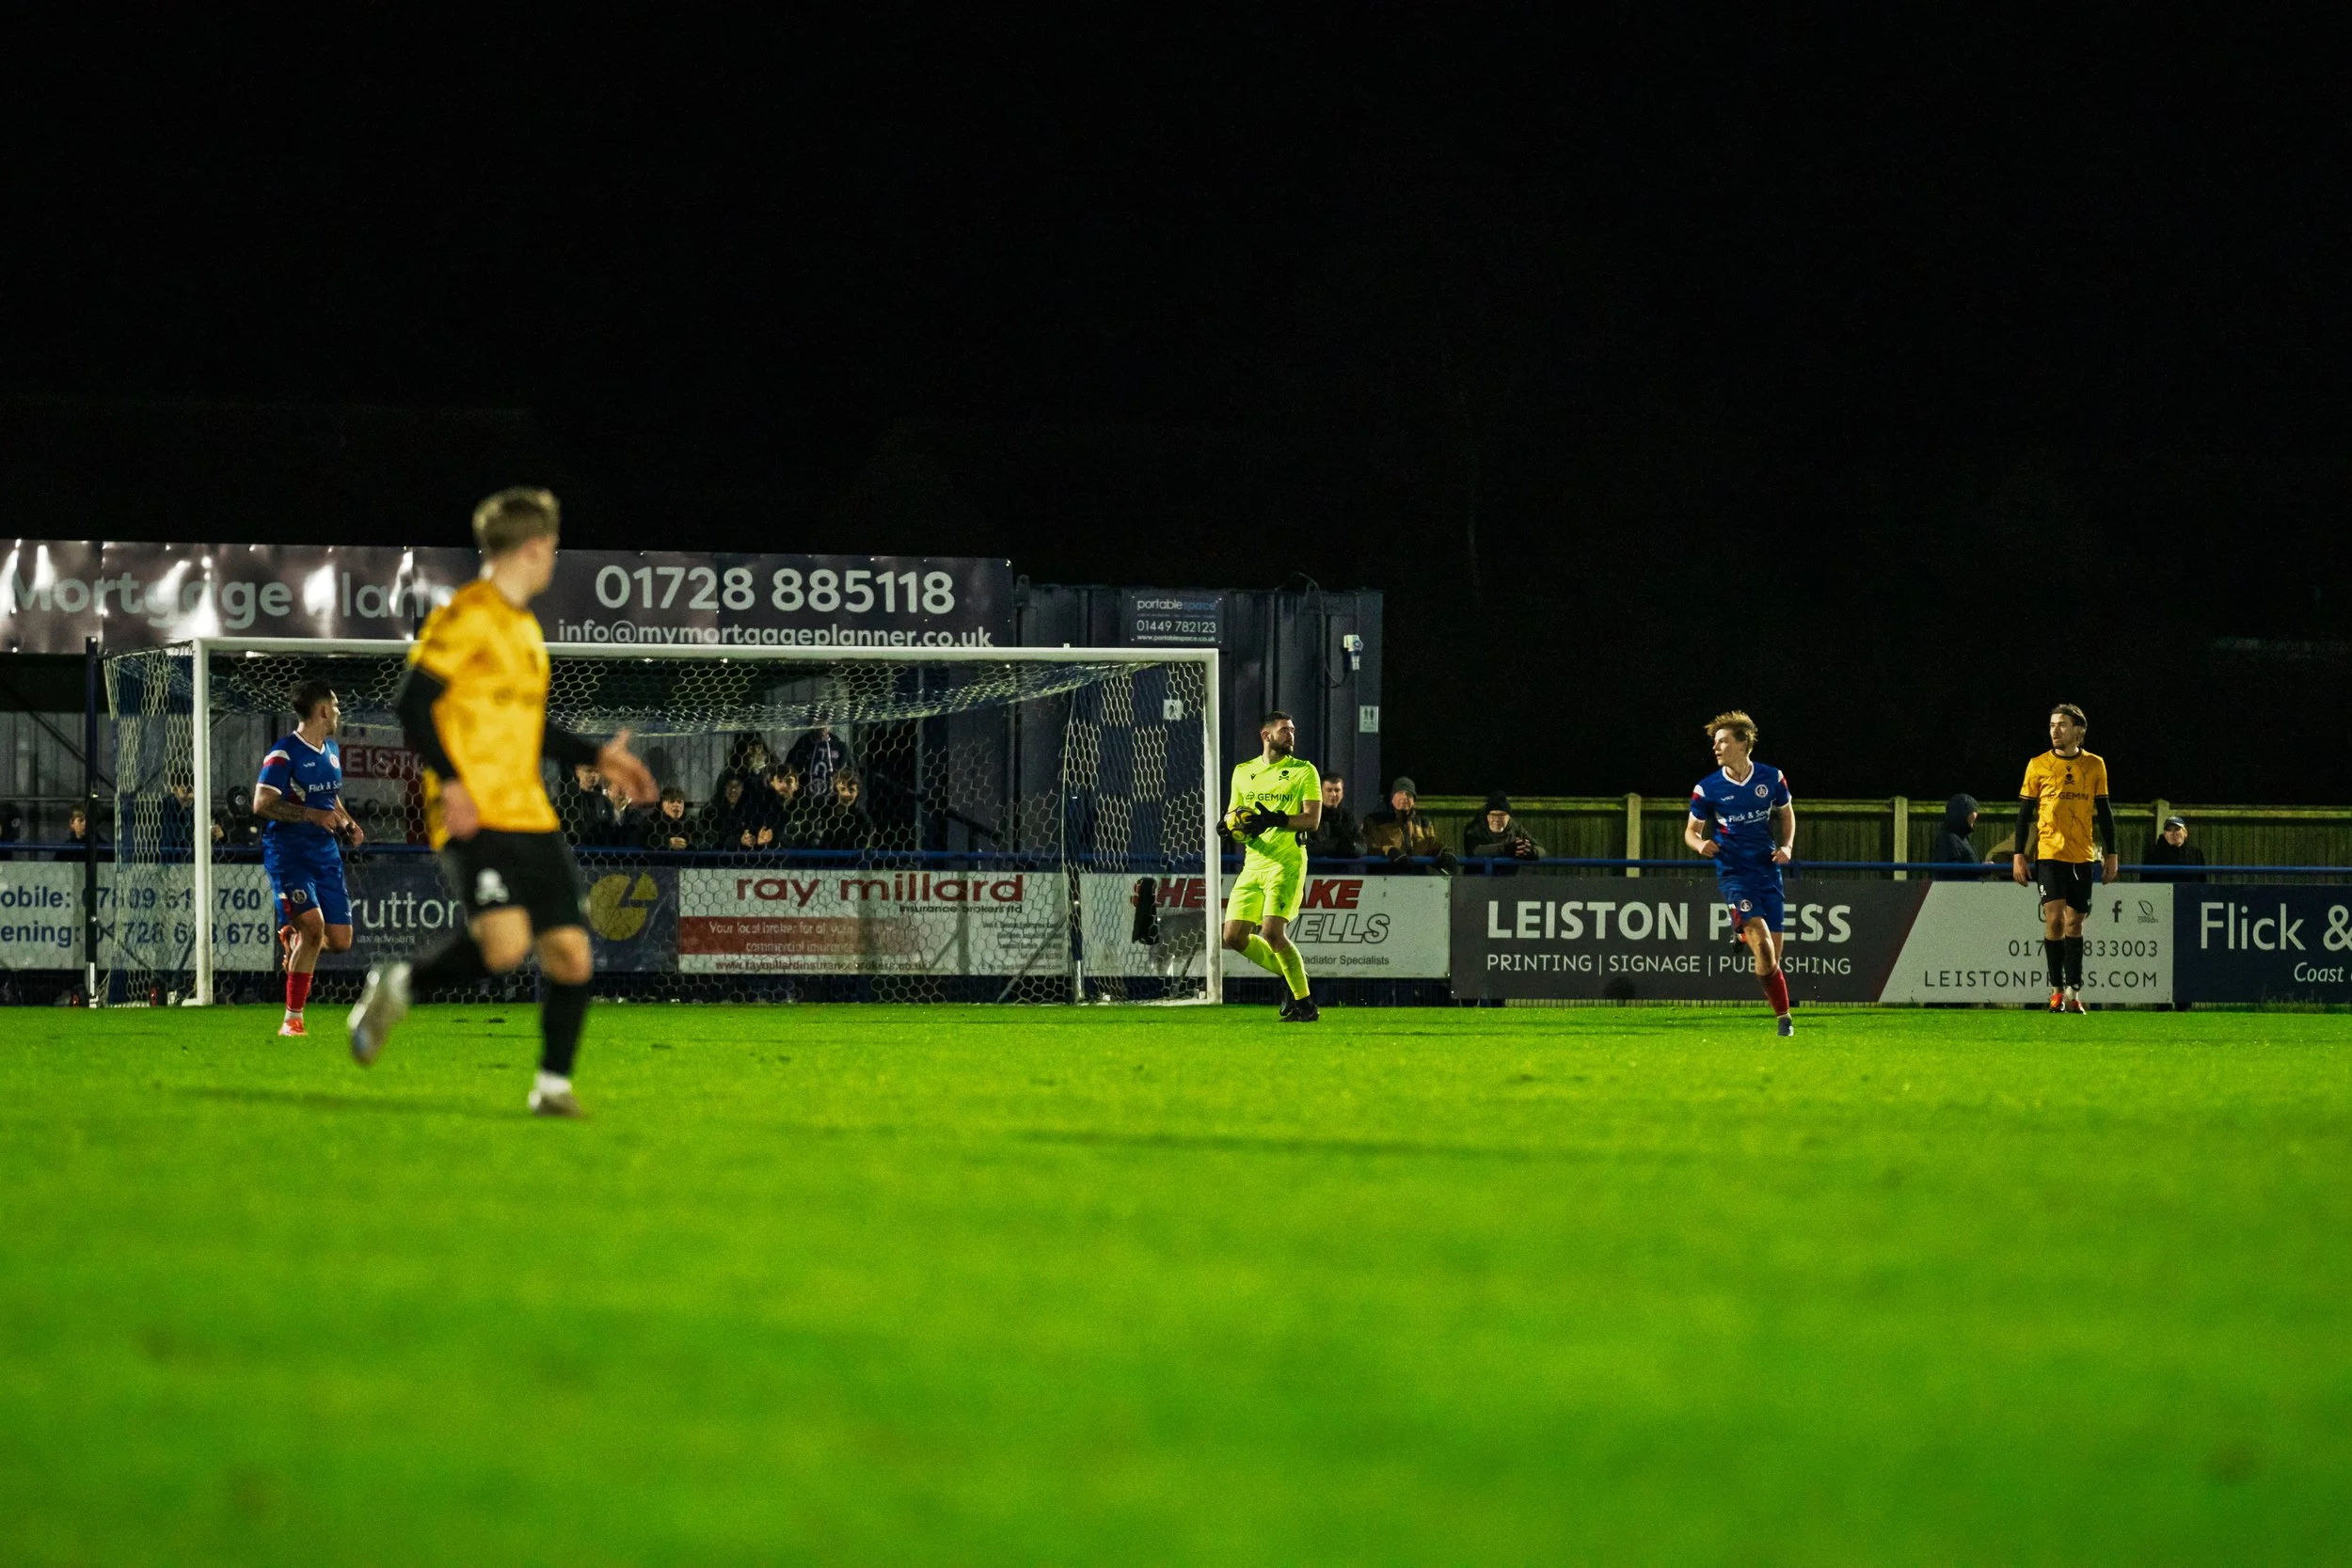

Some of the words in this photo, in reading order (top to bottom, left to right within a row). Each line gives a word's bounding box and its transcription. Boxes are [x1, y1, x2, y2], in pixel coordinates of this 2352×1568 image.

[11, 569, 293, 629] Mortgage
[595, 564, 755, 610] 01728
[771, 568, 955, 614] 885118
[558, 618, 994, 647] info@mymortgageplanner.co.uk
[1136, 620, 1172, 631] 01449
[1175, 622, 1216, 633] 782123
[1257, 793, 1293, 801] GEMINI
[1728, 813, 1746, 823] Flick
[1747, 811, 1755, 819] &
[0, 886, 71, 909] obile:
[218, 888, 261, 910] 760
[736, 879, 821, 907] ray
[840, 873, 1024, 902] millard
[0, 920, 80, 948] ening:
[227, 922, 270, 944] 678
[1488, 901, 1689, 941] LEISTON
[1709, 903, 1851, 943] PESS
[2201, 902, 2306, 950] Flick
[2323, 904, 2352, 951] &
[1340, 956, 1390, 966] Specialists
[2084, 941, 2157, 958] 833003
[1487, 954, 1592, 972] PRINTING
[1610, 956, 1700, 973] SIGNAGE
[1720, 957, 1851, 974] PUBSHING
[2294, 962, 2344, 982] Coast
